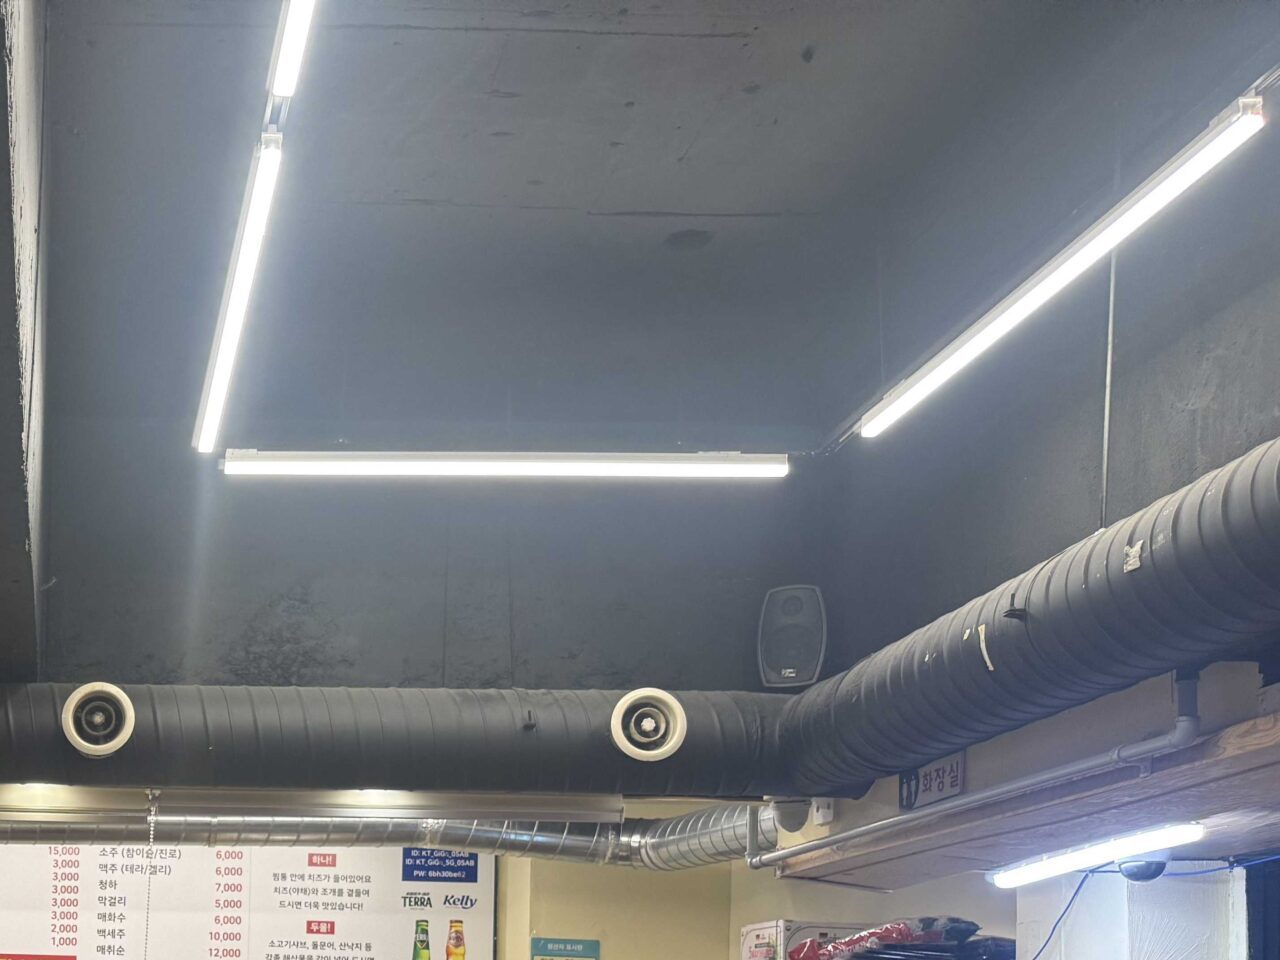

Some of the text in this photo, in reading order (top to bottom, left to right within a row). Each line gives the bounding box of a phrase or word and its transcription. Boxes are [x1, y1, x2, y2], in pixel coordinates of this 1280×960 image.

[919, 760, 958, 792] 화장실
[99, 848, 243, 860] 소주 6,000
[53, 860, 79, 869] 3,000
[99, 864, 117, 874] 맥주
[99, 880, 242, 893] 청하 7,000
[98, 896, 241, 909] 막걸리 5,000
[401, 895, 477, 909] TERRA Kelly
[97, 912, 126, 923] 매화수
[51, 925, 77, 933] 2,000
[97, 929, 125, 939] 백세주
[52, 938, 77, 946] 1,000
